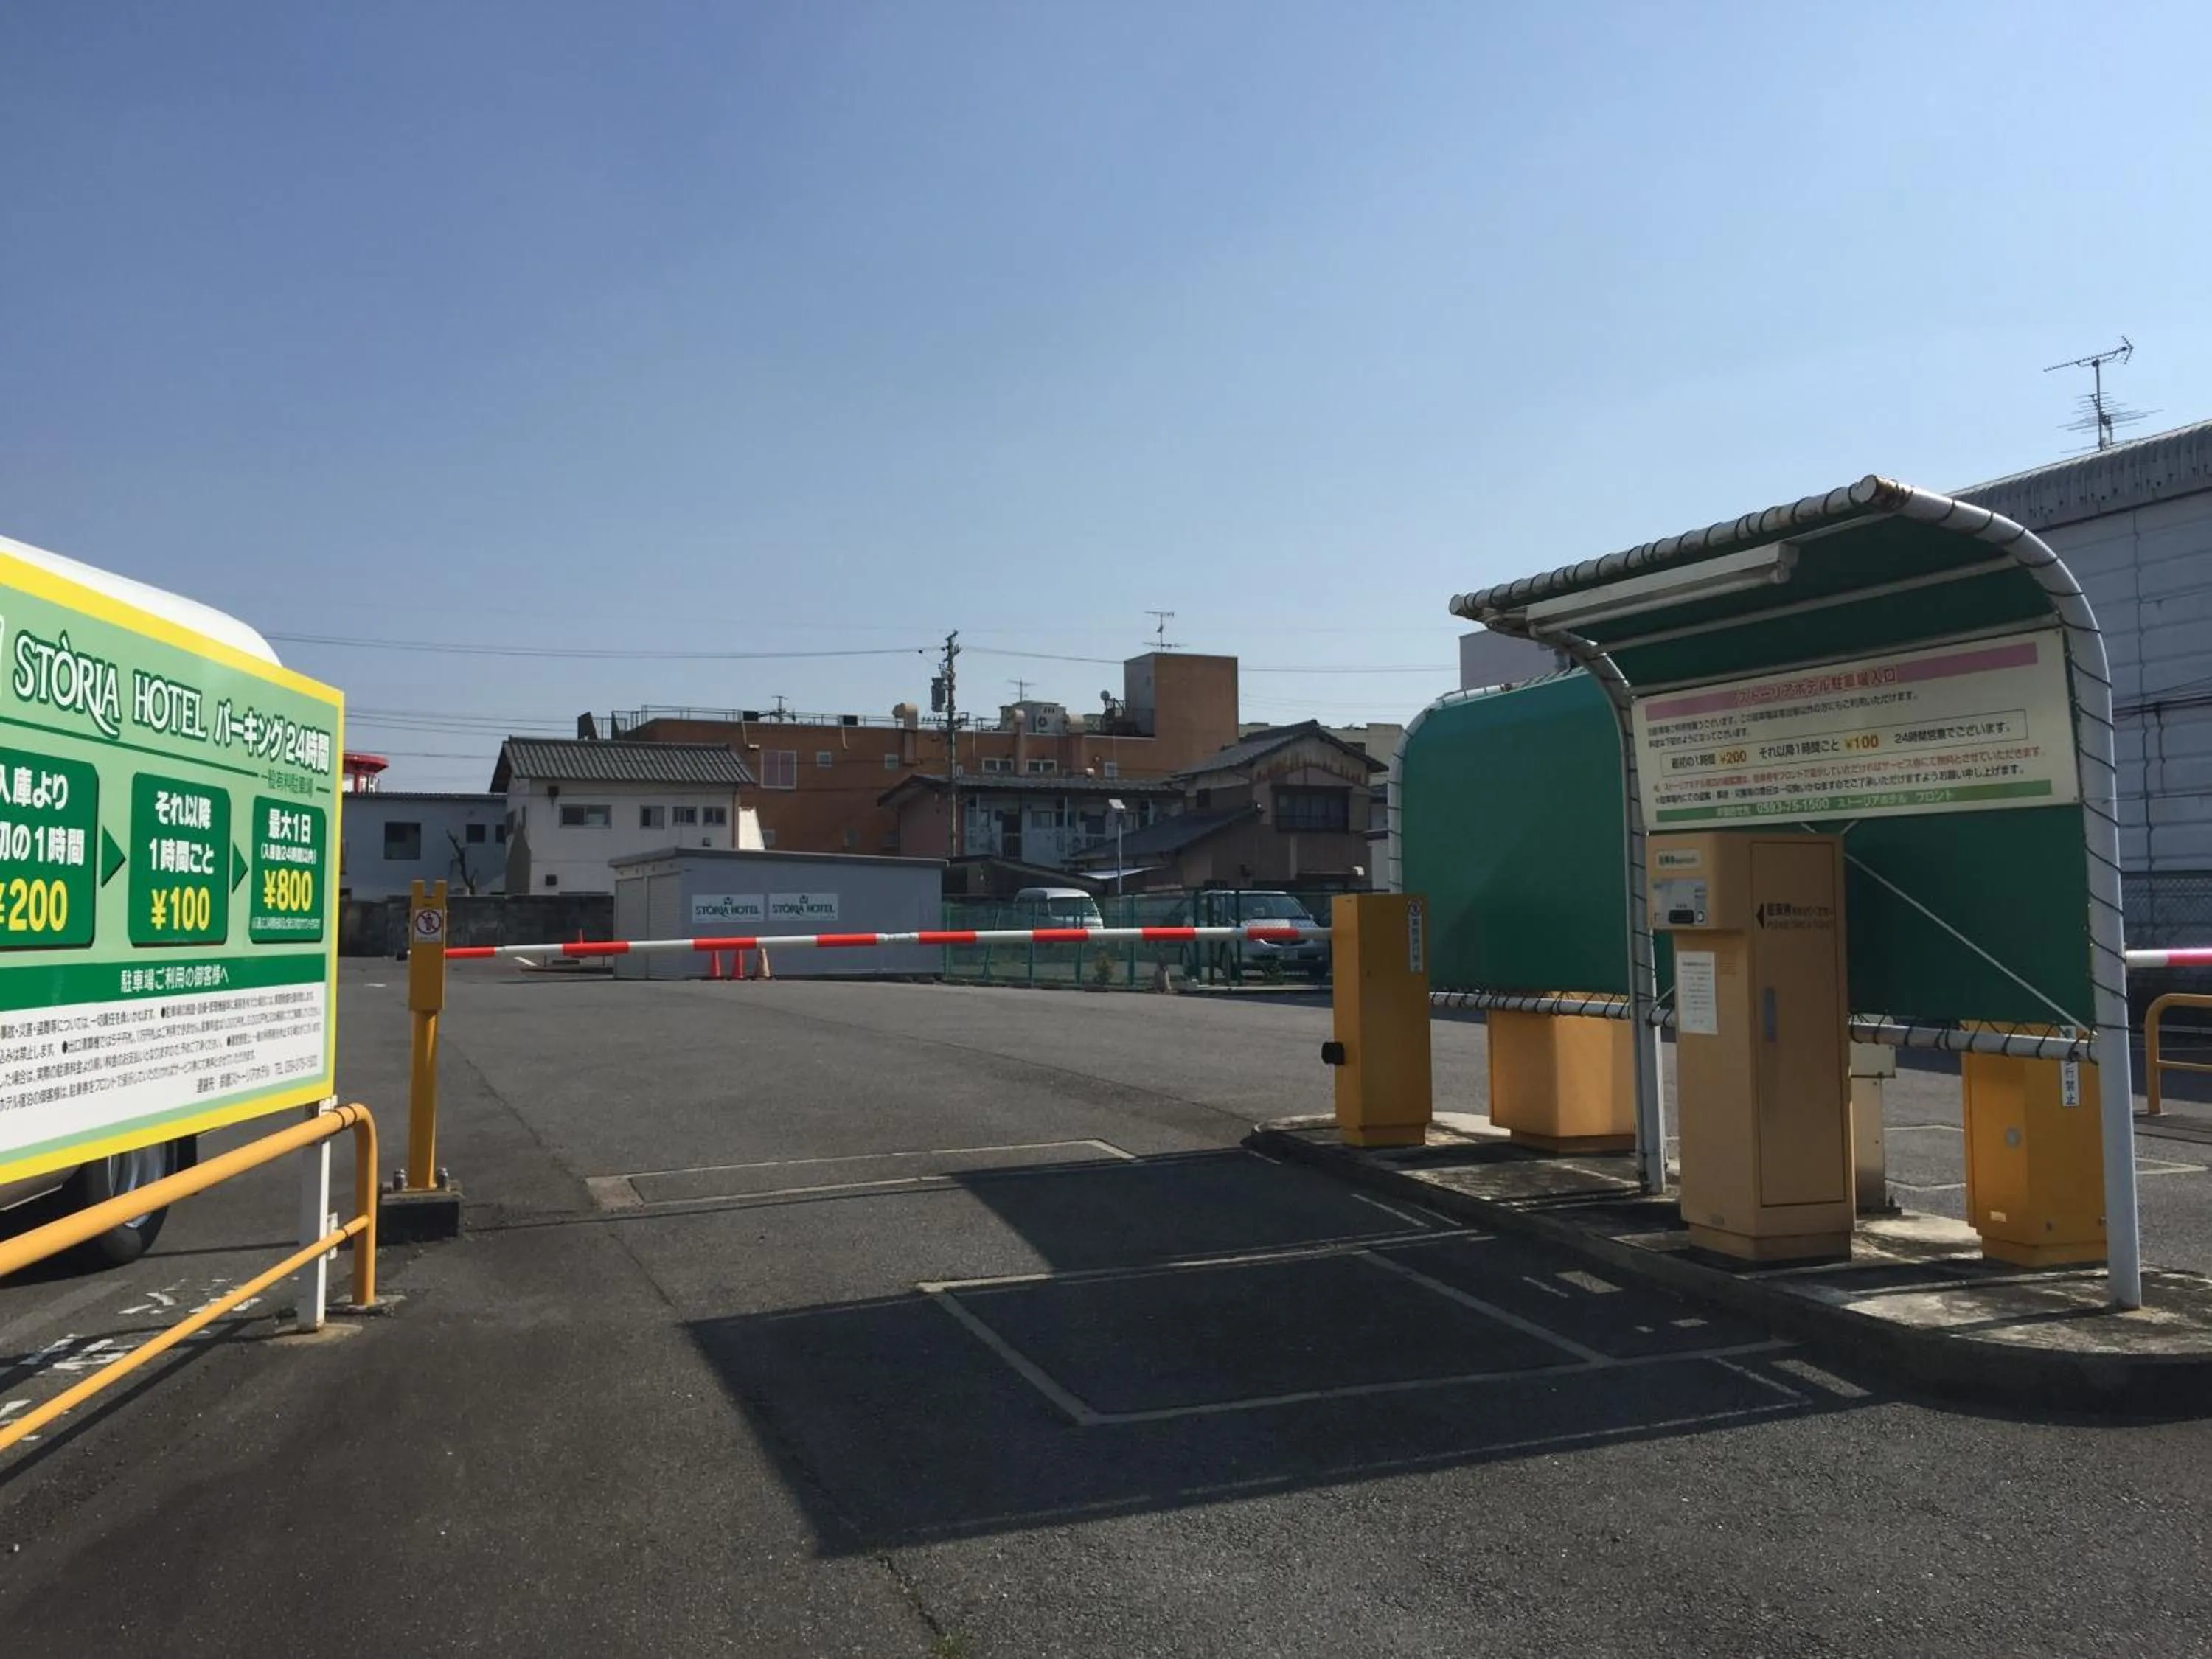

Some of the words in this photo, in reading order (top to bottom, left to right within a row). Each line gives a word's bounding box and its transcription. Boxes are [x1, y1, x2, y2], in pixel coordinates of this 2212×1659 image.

[133, 669, 207, 741] HOTEL
[1719, 749, 1747, 765] ¥200
[1846, 734, 1879, 750] ¥100
[155, 791, 212, 830] それ以降
[1916, 790, 1953, 803] フロント
[268, 808, 312, 844] 最大1日
[150, 838, 215, 874] 1時間ごと
[263, 868, 313, 912] ¥800
[151, 886, 211, 931] ¥100
[731, 905, 762, 915] HOTEL
[807, 904, 835, 914] HOTEL
[121, 964, 229, 993] 駐車場ご利用の御客様へ
[2065, 1060, 2076, 1105] 行禁止
